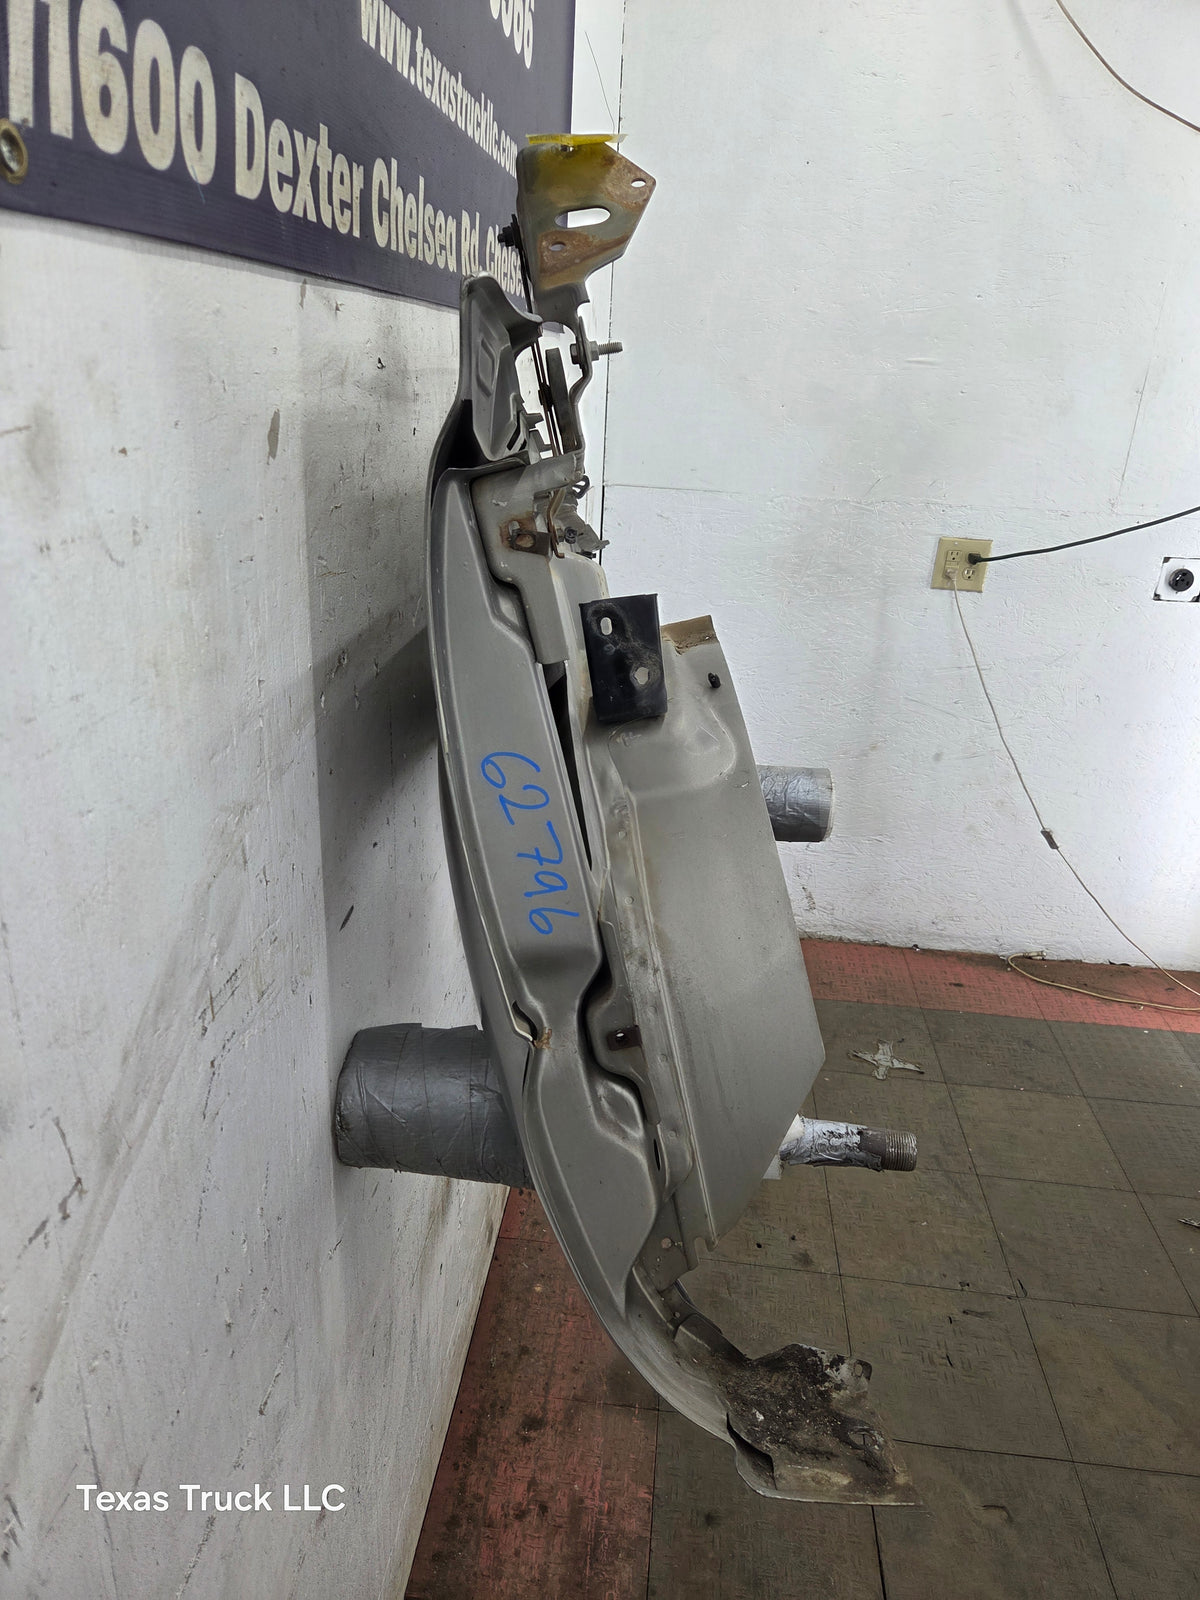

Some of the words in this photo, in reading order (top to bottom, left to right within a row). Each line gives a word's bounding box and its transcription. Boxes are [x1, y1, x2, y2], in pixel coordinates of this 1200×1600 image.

[7, 0, 217, 185] 11600
[235, 72, 364, 238] Dexter
[372, 157, 457, 272] Chelsea
